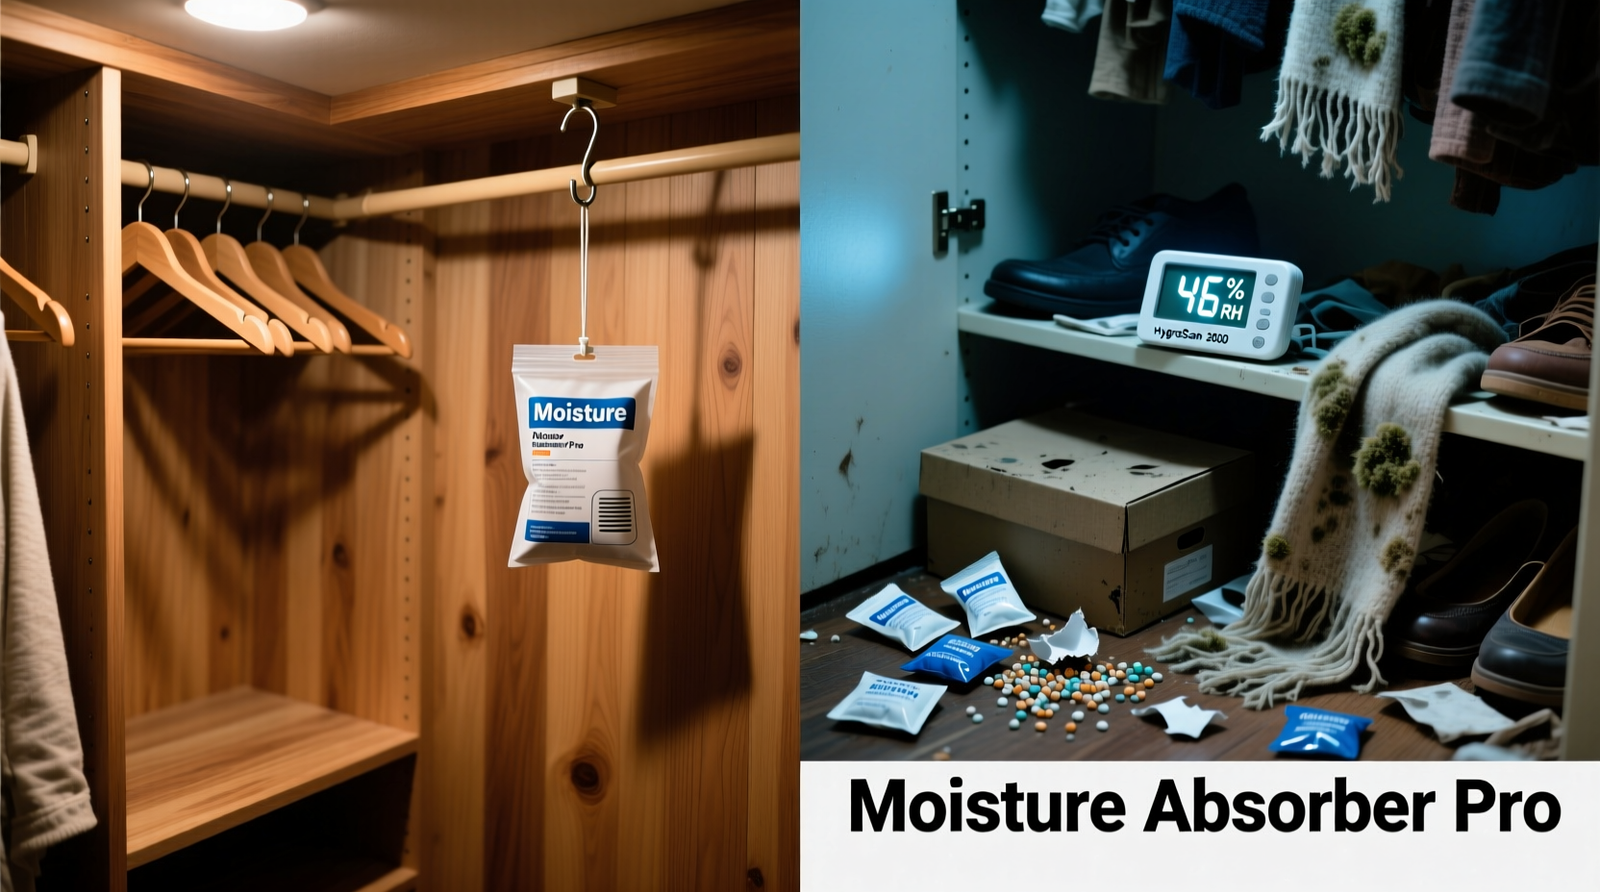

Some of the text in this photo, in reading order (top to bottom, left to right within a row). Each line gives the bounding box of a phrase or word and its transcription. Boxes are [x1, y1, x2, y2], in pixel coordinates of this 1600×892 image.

[1177, 274, 1245, 318] 46 %
[1220, 303, 1244, 321] RH
[533, 402, 627, 423] Moisture
